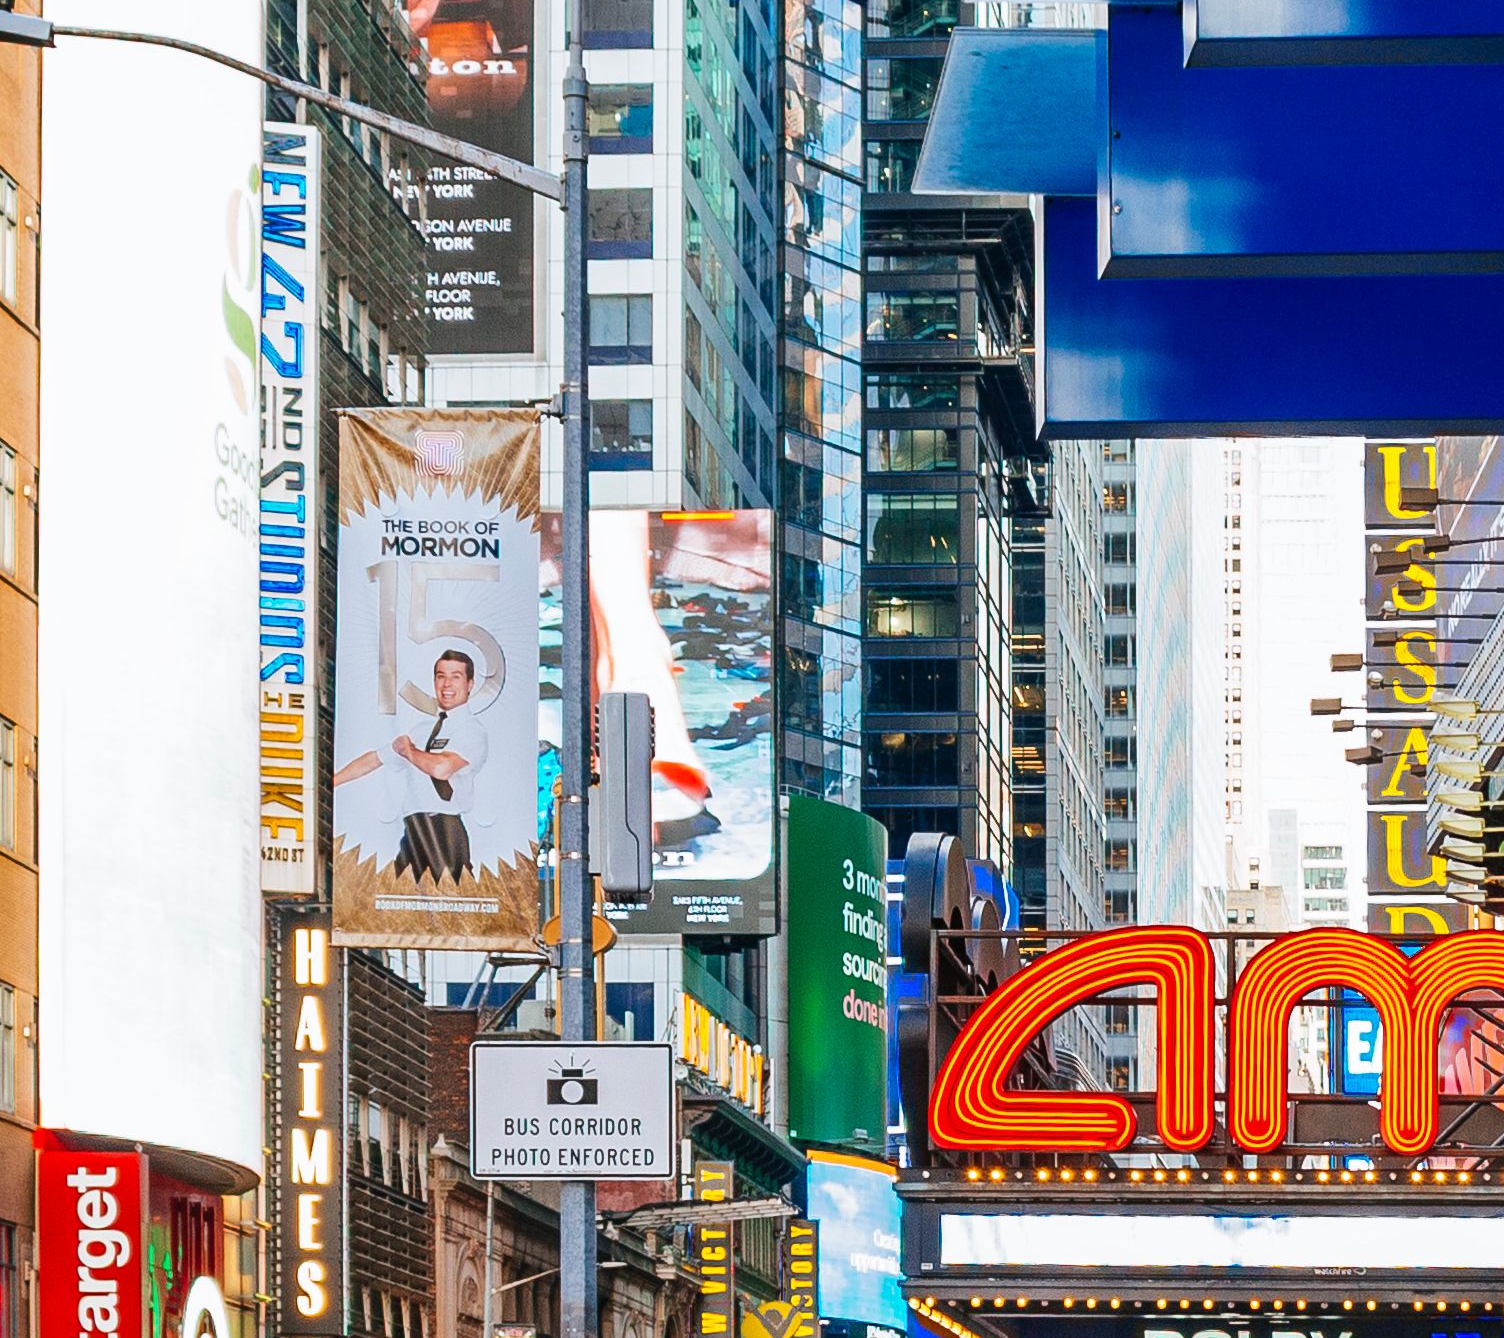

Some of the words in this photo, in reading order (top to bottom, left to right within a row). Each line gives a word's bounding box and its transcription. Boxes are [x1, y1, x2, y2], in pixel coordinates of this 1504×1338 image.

[433, 184, 474, 199] YORK
[457, 217, 512, 233] AVENUE
[433, 237, 474, 251] YORK
[441, 271, 501, 287] AVENUE,
[426, 290, 471, 304] FLOOR
[433, 307, 474, 321] YORK
[381, 519, 413, 534] THE
[418, 520, 469, 535] BOOK
[474, 521, 500, 536] OF
[381, 536, 500, 560] MORMON
[365, 560, 506, 716] 15
[504, 1118, 540, 1136] BUS
[549, 1118, 642, 1136] CORRIDOR
[491, 1148, 551, 1166] PHOTO
[558, 1148, 655, 1167] ENFORCED
